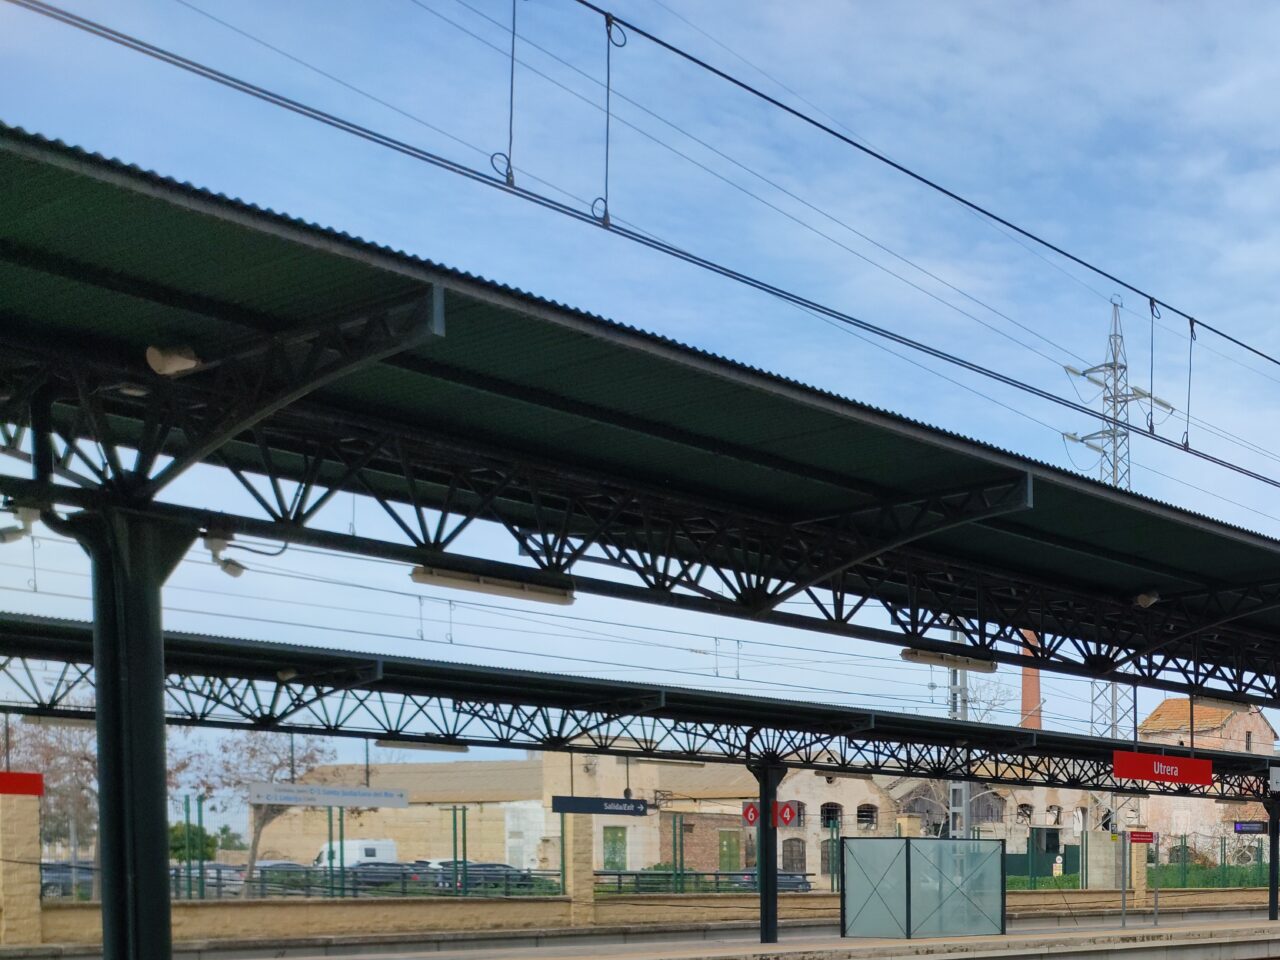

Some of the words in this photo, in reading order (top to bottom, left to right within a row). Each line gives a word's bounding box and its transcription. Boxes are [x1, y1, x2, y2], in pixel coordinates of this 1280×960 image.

[1153, 761, 1179, 777] Utrera
[748, 808, 755, 821] 6
[783, 808, 791, 821] 4
